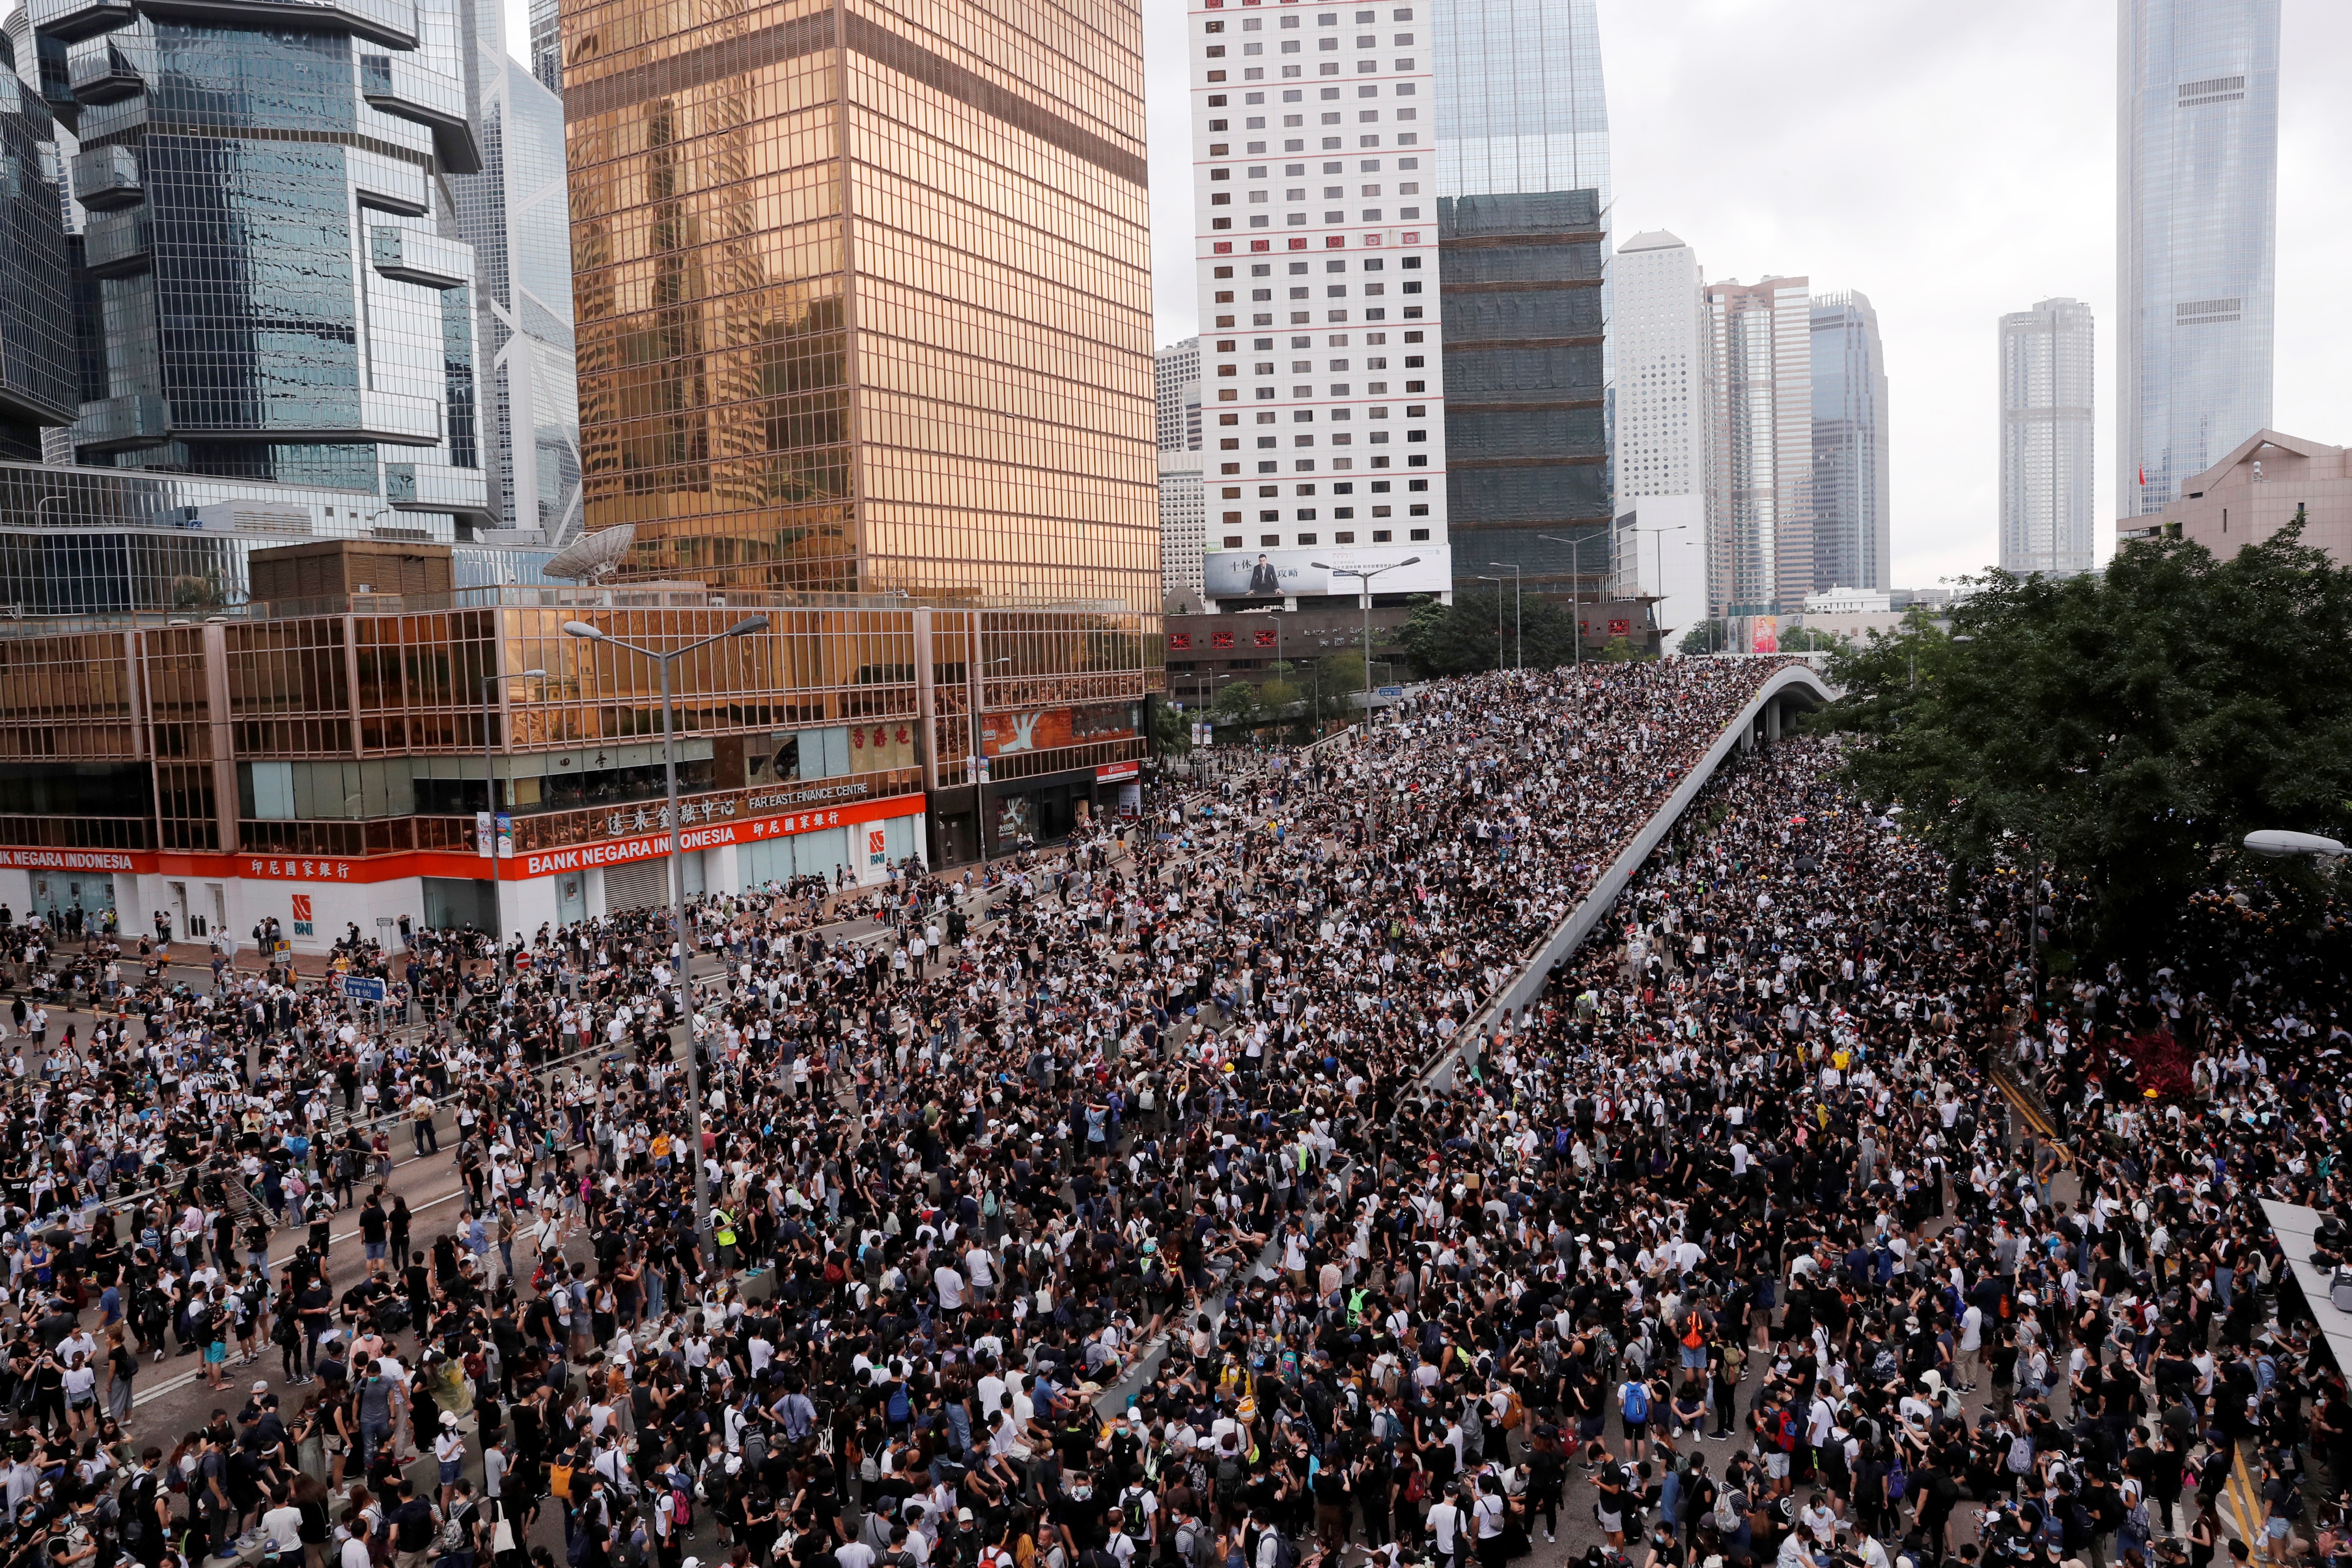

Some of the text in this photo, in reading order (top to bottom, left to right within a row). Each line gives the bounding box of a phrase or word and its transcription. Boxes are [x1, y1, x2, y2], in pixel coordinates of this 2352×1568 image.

[1277, 568, 1298, 578] 攻略
[852, 724, 910, 748] 香港地
[749, 782, 867, 809] FAR EAST FINANCE CENTRE
[753, 811, 838, 837] 印尼國家銀行
[13, 851, 64, 867] NEGARA
[65, 853, 133, 870] INDONESIA
[528, 851, 579, 874] BANK
[582, 841, 652, 865] NEGARA
[870, 853, 885, 865] BNI
[251, 859, 349, 879] 印尼國家銀行
[294, 922, 313, 936] BNI
